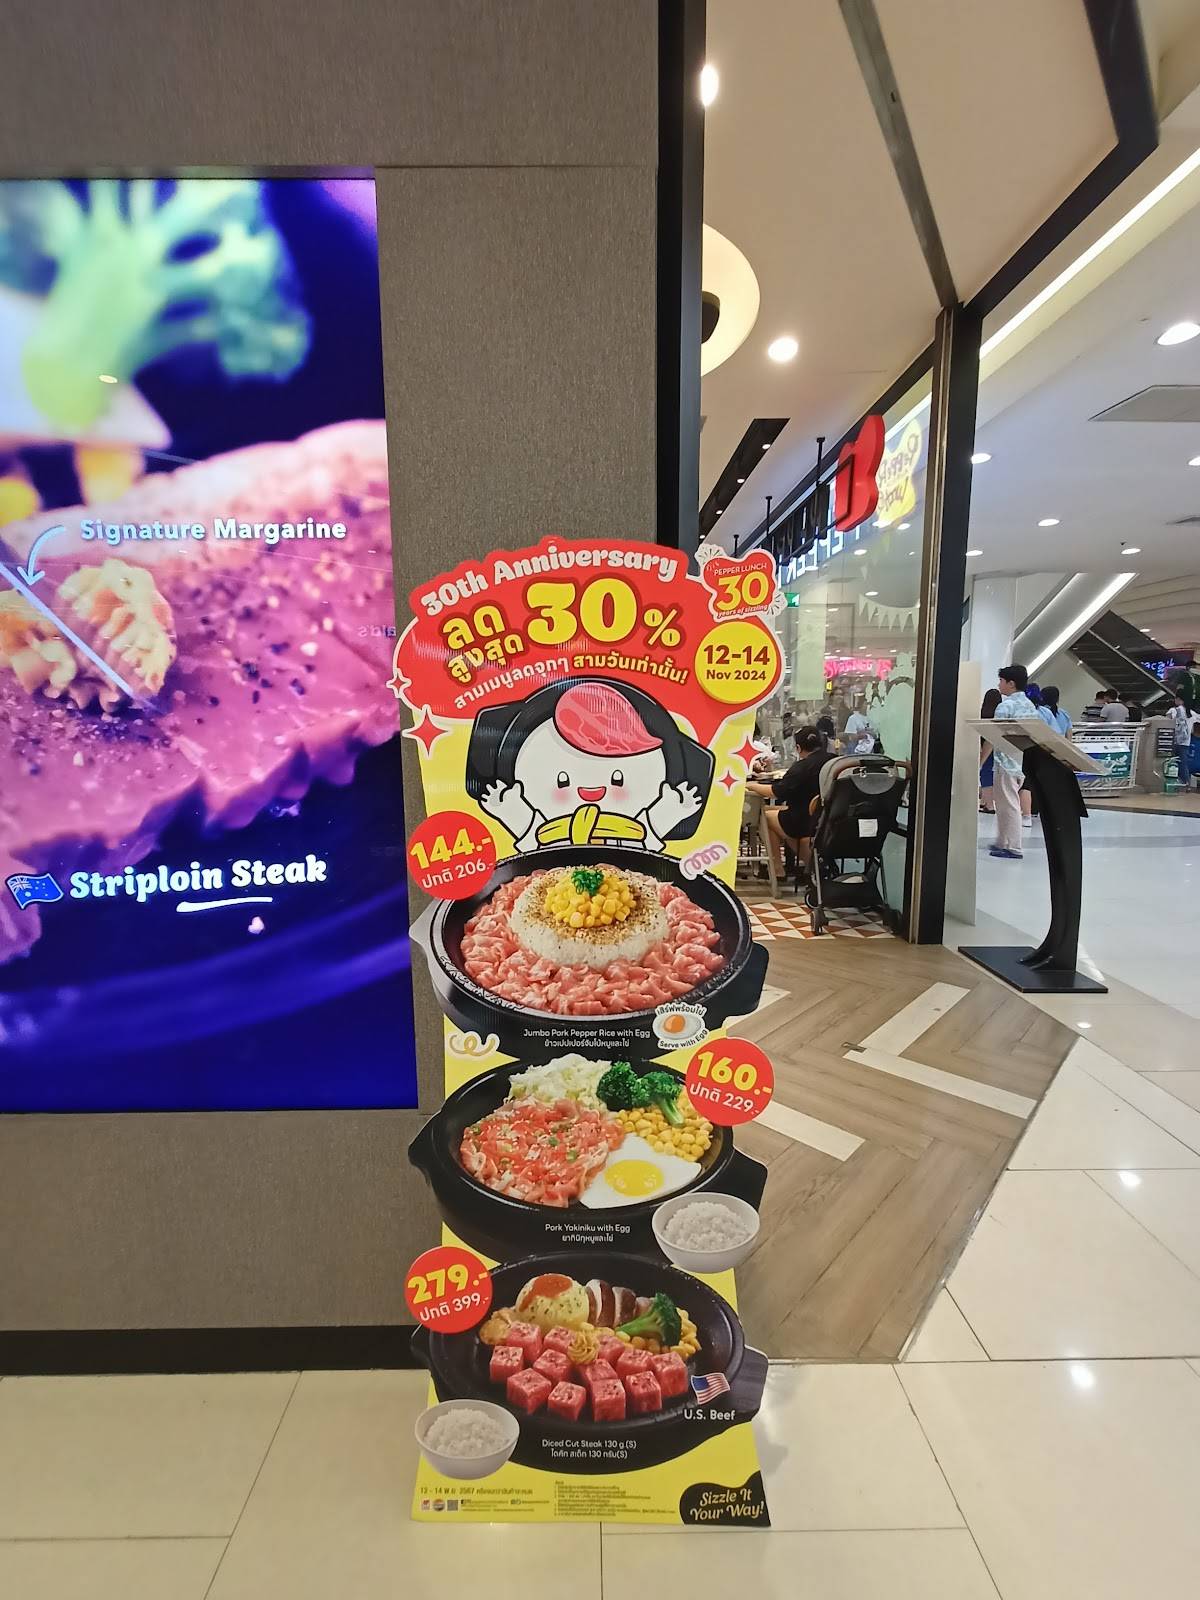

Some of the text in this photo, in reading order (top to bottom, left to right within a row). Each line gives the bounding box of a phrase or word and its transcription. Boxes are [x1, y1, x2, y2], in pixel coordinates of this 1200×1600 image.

[80, 517, 347, 544] Signature Margarine
[421, 545, 679, 616] 30th Anniversary
[714, 562, 767, 576] PEPPER LUNCH
[716, 571, 769, 611] 30
[717, 609, 736, 619] years
[737, 607, 744, 615] of
[442, 605, 506, 650] ลด
[447, 632, 525, 683] สูงสุด
[573, 651, 689, 684] สามวันเท่านั้น!
[703, 645, 771, 666] 12-14
[706, 669, 767, 681] Nov 2024
[410, 828, 492, 870] 144.-
[70, 854, 327, 902] Striploin Steak
[422, 858, 494, 889] ปกติ 206.-
[523, 1029, 651, 1038] Jumbo Pork Pepper Rice with Egg
[660, 1029, 708, 1048] Serve with Egg
[698, 1051, 772, 1095] 160.-
[689, 1082, 761, 1116] ปกติ 229.-
[545, 1223, 631, 1234] Pork Yakiniku with Egg
[407, 1265, 489, 1304] 279.-
[419, 1292, 490, 1323] ปกติ 399.-
[684, 1408, 736, 1421] U.S. Beef
[542, 1439, 564, 1448] Diced
[565, 1439, 580, 1448] Cut
[581, 1439, 602, 1448] Steak
[604, 1439, 618, 1448] 130
[626, 1439, 637, 1449] (S)
[589, 1450, 602, 1458] 130
[690, 1501, 765, 1521] Your Way!
[700, 1488, 753, 1507] Sizzle It
